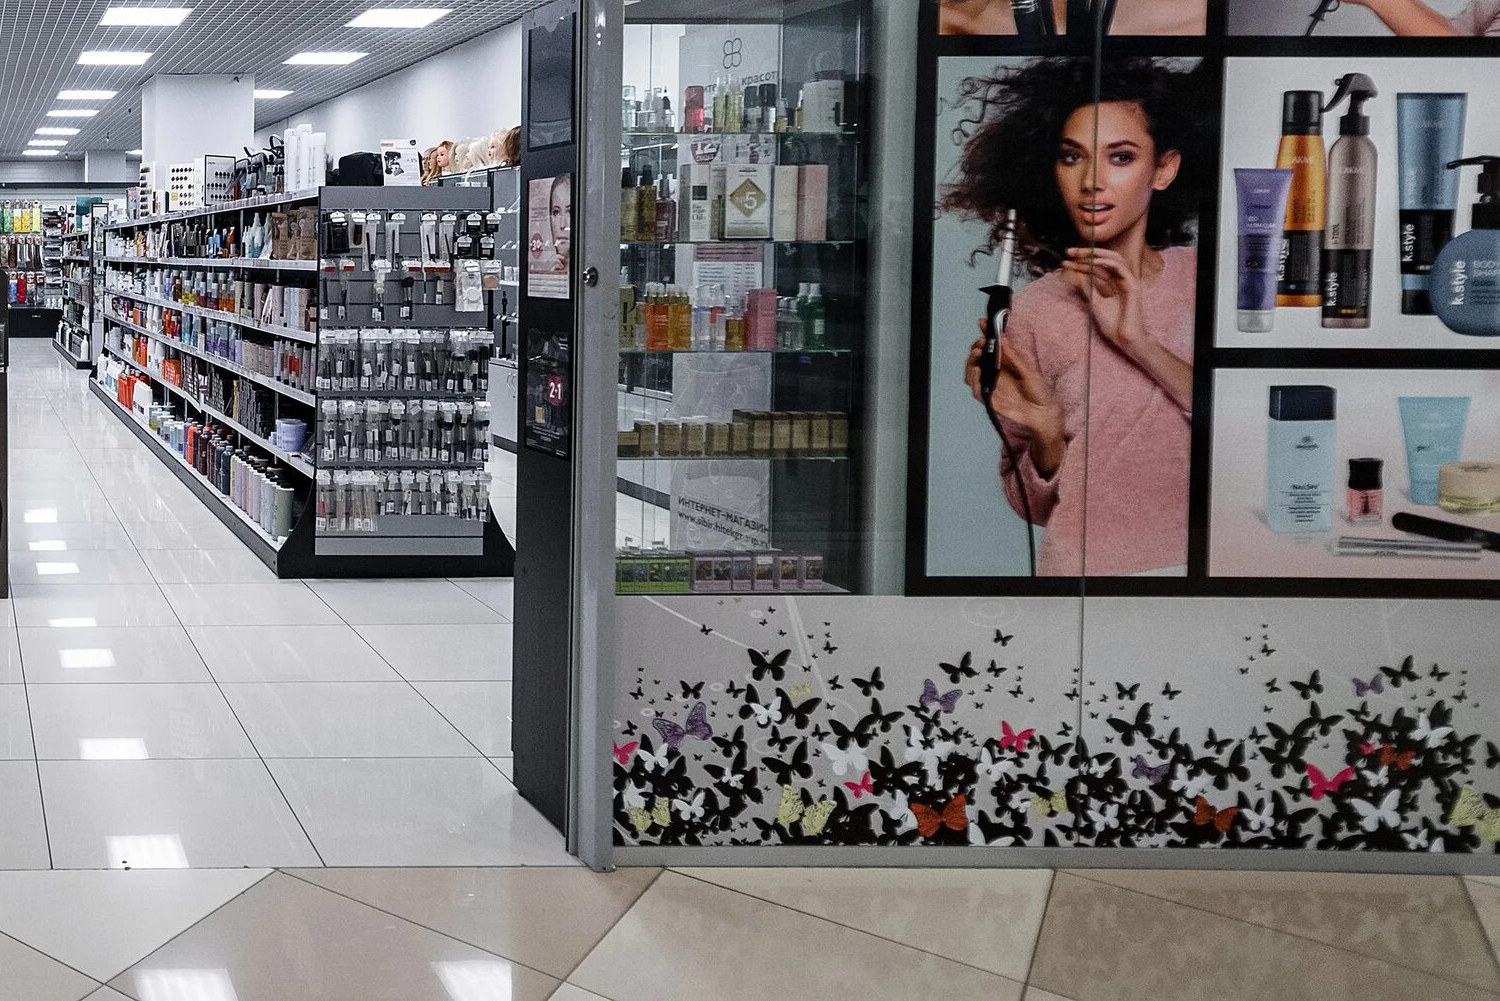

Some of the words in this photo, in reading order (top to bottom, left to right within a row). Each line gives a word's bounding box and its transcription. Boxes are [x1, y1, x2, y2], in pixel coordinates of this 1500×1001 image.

[1403, 223, 1416, 263] k.style
[1323, 271, 1339, 308] k.style
[1450, 259, 1468, 306] k.style
